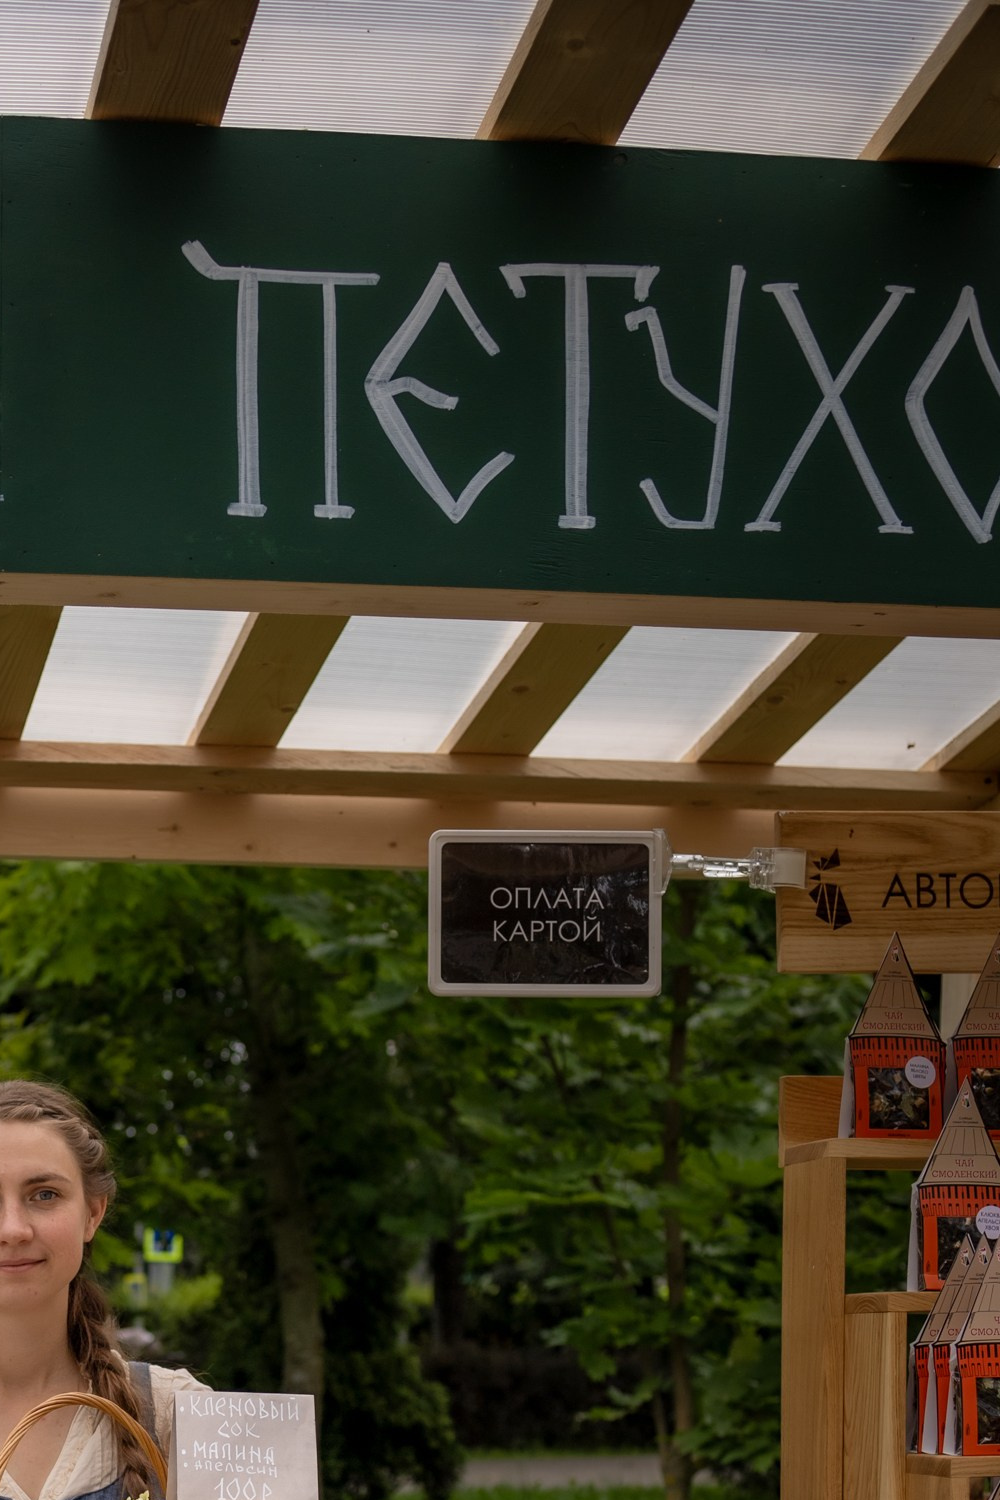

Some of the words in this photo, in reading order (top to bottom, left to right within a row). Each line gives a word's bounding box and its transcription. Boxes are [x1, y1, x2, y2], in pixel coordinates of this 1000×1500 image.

[490, 887, 605, 910] ОПЛАТА
[493, 915, 603, 943] КАРТОЙ
[884, 1011, 904, 1020] ЧАЙ
[862, 1022, 926, 1031] СМОЛЕНСКИЙ
[955, 1159, 974, 1168] ЧАЙ
[932, 1170, 998, 1179] СМОЛЕНСКИЙ
[190, 1395, 300, 1421] КЛЕНОВЫЙ
[217, 1420, 260, 1439] СОК
[193, 1440, 276, 1466] МАЛИНА
